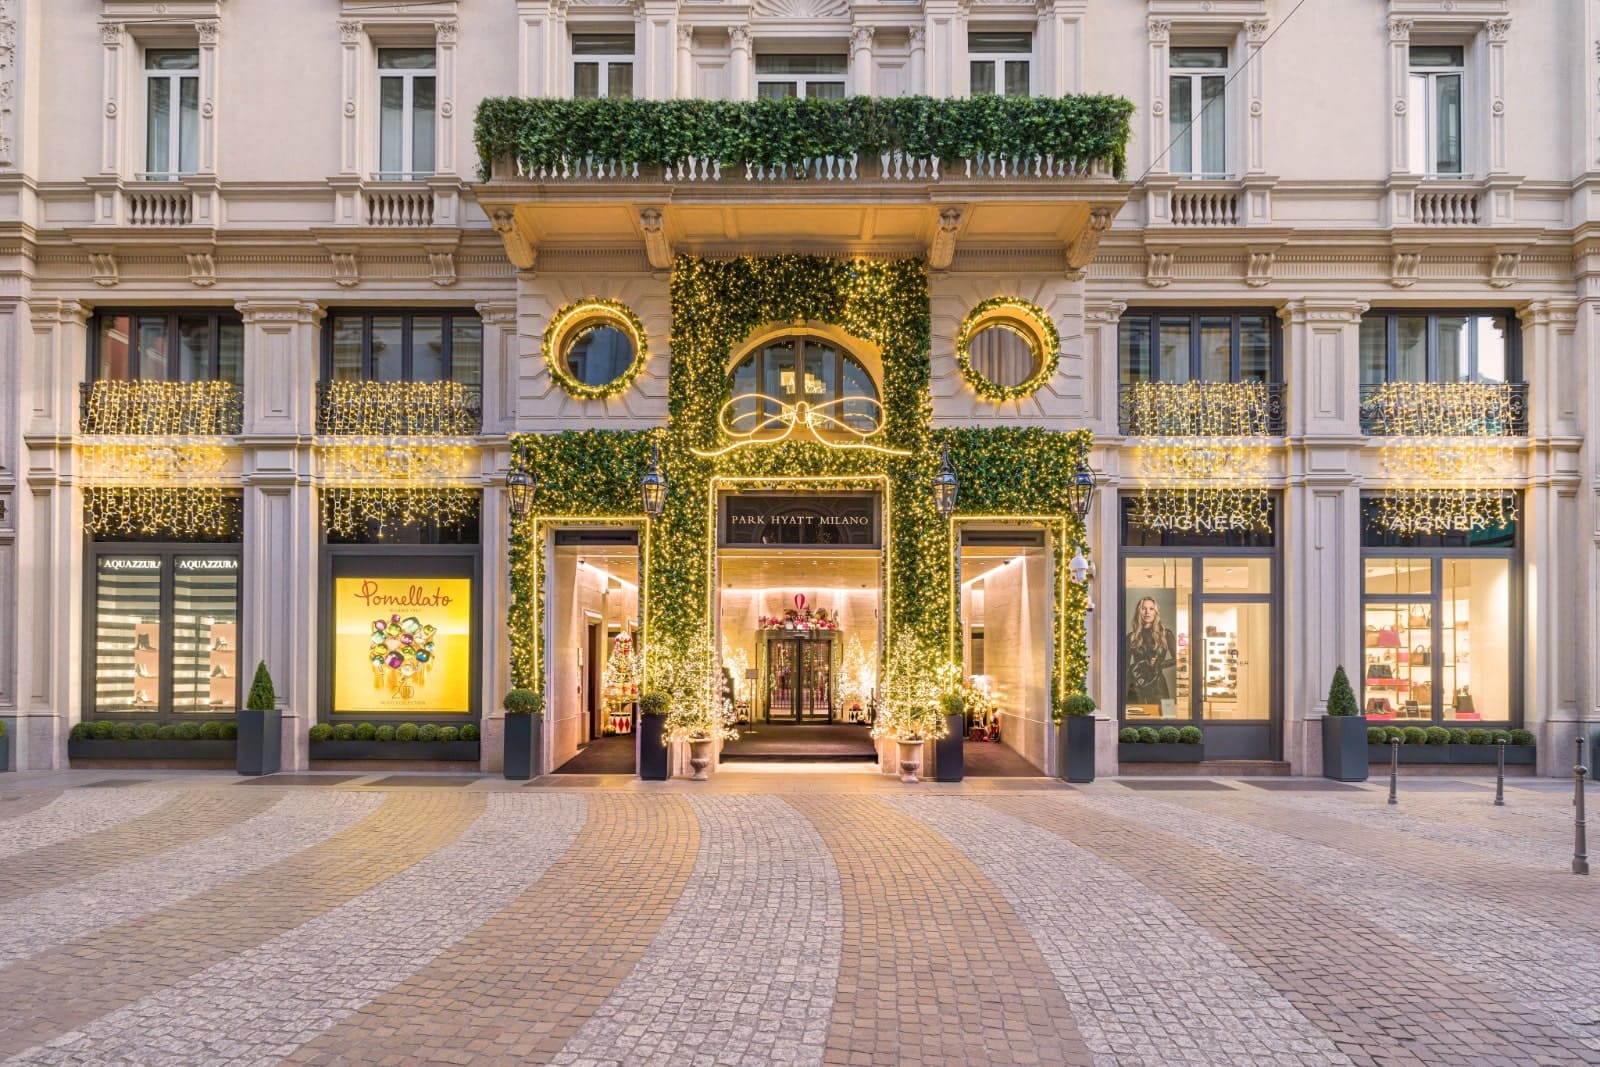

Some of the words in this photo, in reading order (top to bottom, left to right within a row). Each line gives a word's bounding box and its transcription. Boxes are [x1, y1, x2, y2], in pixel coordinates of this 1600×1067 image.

[731, 515, 765, 525] PARK
[771, 515, 814, 525] HYATT
[820, 516, 869, 525] MILANO
[1150, 515, 1248, 530] AIGNER
[1389, 515, 1486, 530] AIGNER
[179, 560, 238, 570] AQUAZZURA
[354, 580, 453, 607] Pomellato
